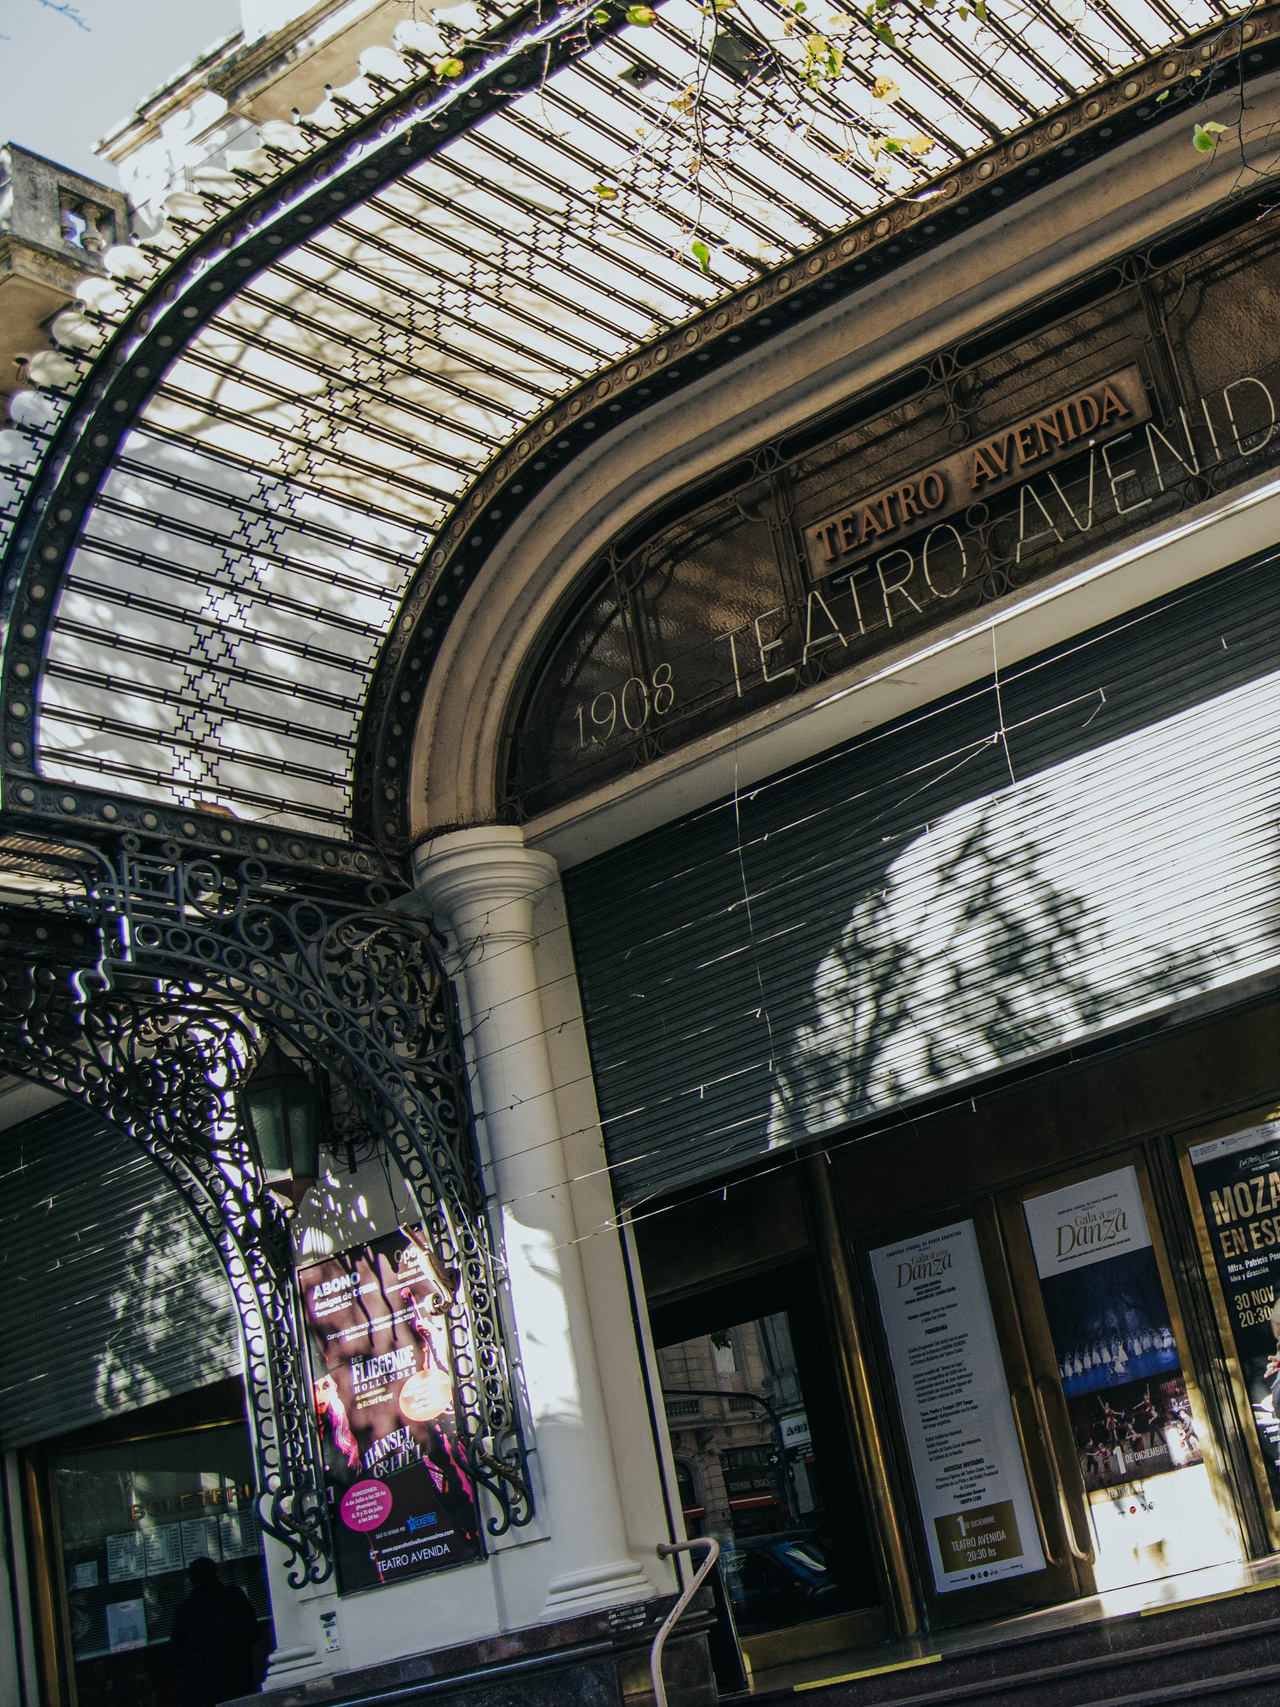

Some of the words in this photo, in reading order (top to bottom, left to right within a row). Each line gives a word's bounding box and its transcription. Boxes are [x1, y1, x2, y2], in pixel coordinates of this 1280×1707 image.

[815, 472, 945, 565] TEATRO
[969, 385, 1130, 491] AVENIDA
[573, 663, 675, 749] 1908
[714, 523, 967, 697] TEATRO
[1074, 1211, 1097, 1227] Gala
[1098, 1210, 1106, 1220] a
[1106, 1206, 1122, 1218] pura
[1055, 1211, 1129, 1258] Danza
[1219, 1227, 1249, 1259] EN
[896, 1253, 952, 1290] Danza
[911, 1253, 929, 1265] Gala
[1227, 1263, 1245, 1274] Mtra.
[1244, 1255, 1269, 1269] Patricia
[1246, 1266, 1269, 1279] dirección
[312, 1272, 361, 1300] ABONO
[1234, 1292, 1251, 1311] 30
[1251, 1285, 1275, 1306] NOV
[314, 1297, 342, 1312] Amigos
[342, 1291, 352, 1300] de
[925, 1324, 948, 1336] PROGRAMA
[351, 1345, 417, 1385] FLIEGENDE
[364, 1425, 411, 1470] HÄNSEL
[374, 1444, 424, 1479] GRETEL
[1112, 1445, 1127, 1475] 1
[1124, 1453, 1135, 1464] DE
[1134, 1444, 1169, 1462] DICIEMBRE
[131, 1484, 252, 1521] BOLETERI
[352, 1486, 378, 1498] FUNCIONES:
[956, 1515, 967, 1537] 1
[971, 1515, 996, 1528] DICIEMBRE
[951, 1536, 977, 1552] TEATRO
[977, 1530, 1007, 1546] AVENIDA
[988, 1546, 997, 1557] hs
[376, 1555, 409, 1572] TEATRO
[411, 1543, 451, 1563] AVENIDA
